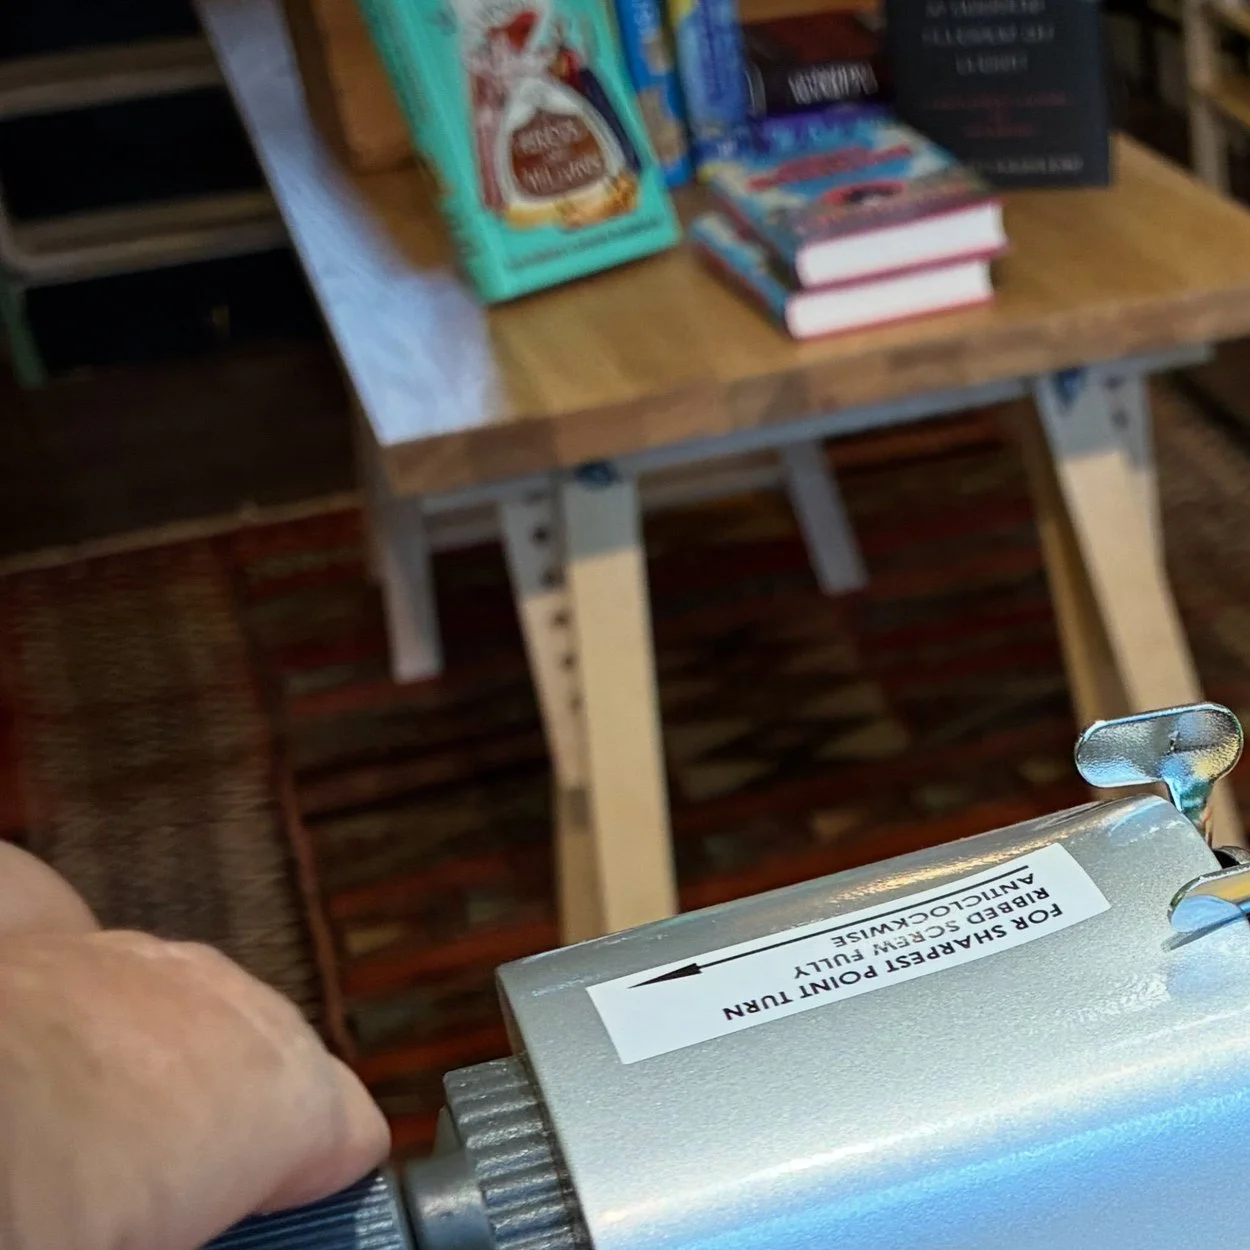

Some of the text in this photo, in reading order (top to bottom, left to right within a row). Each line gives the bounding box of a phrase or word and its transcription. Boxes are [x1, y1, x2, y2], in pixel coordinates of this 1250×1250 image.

[794, 887, 1051, 980] RIBBED SCREW FULLY
[830, 872, 1035, 948] ANTICLOCKWISE
[722, 902, 1064, 1022] FOR SHARPEST POINT TURN
